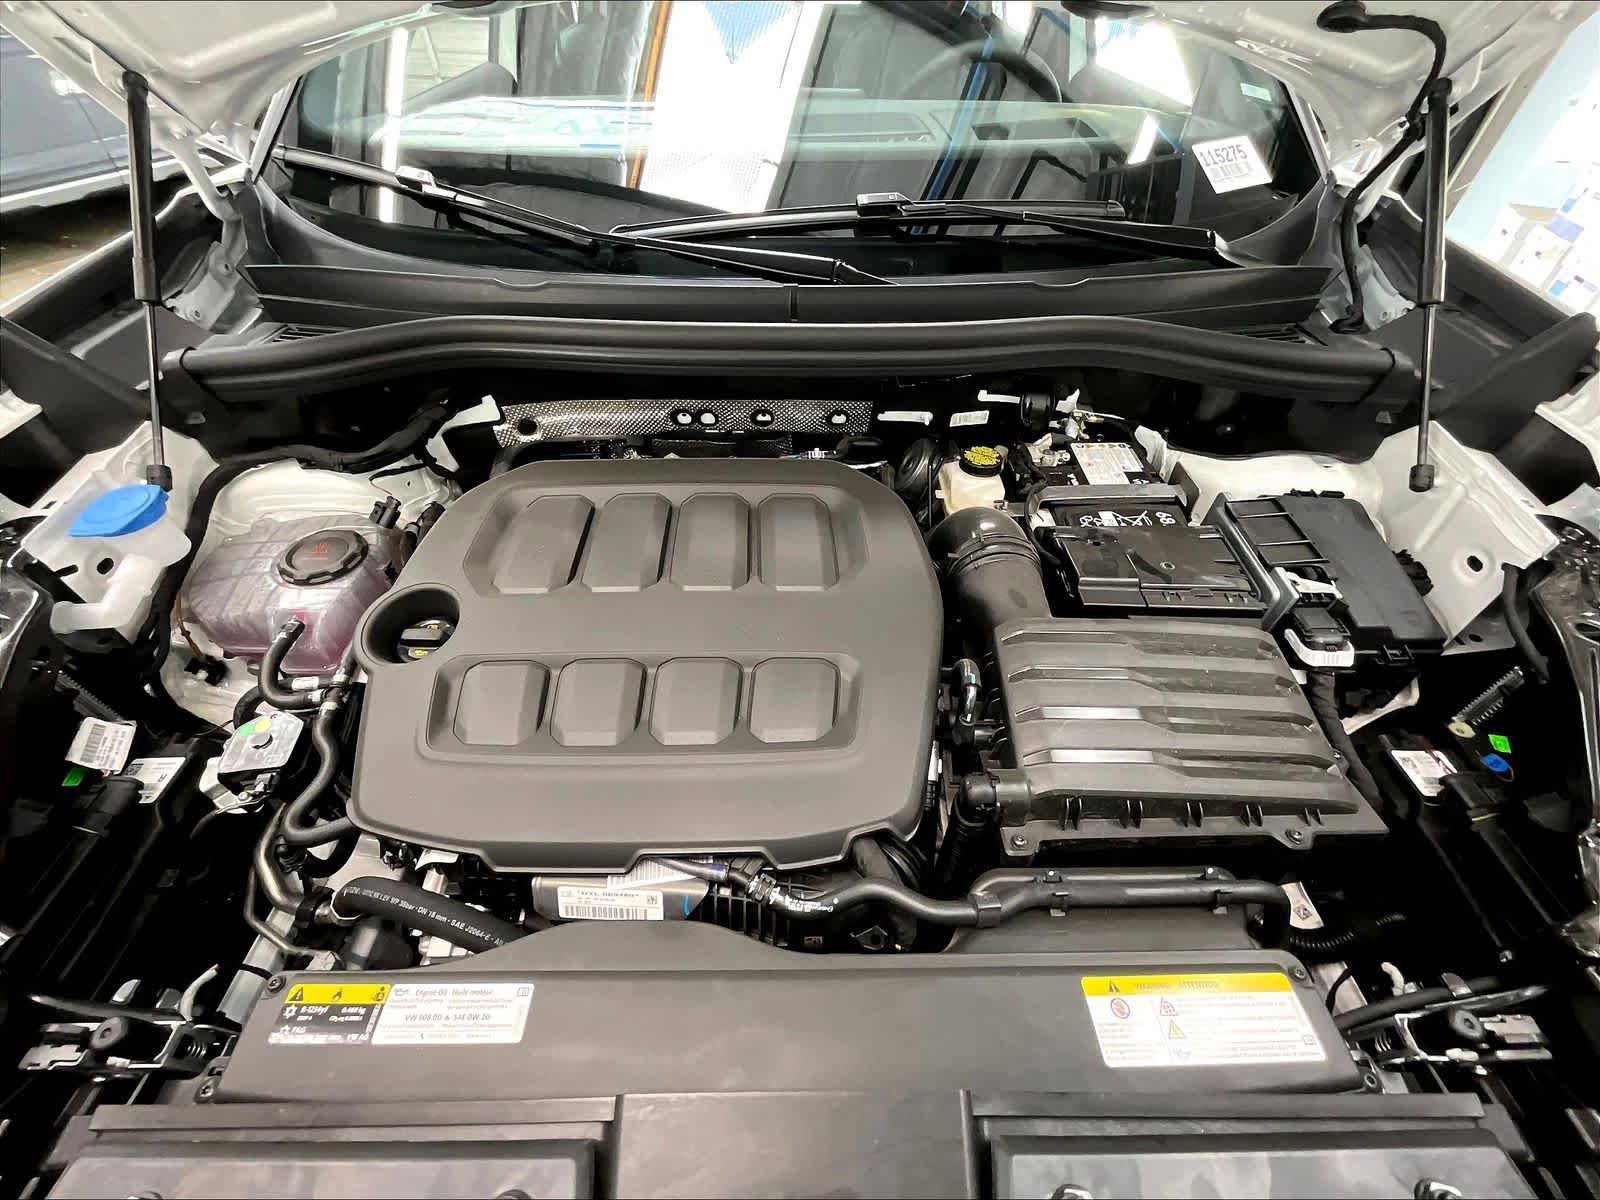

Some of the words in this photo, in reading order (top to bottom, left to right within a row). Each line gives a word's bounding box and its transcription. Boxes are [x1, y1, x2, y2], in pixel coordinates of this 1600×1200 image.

[1199, 144, 1248, 167] 115275
[451, 919, 465, 931] SAE
[405, 1014, 417, 1022] VW
